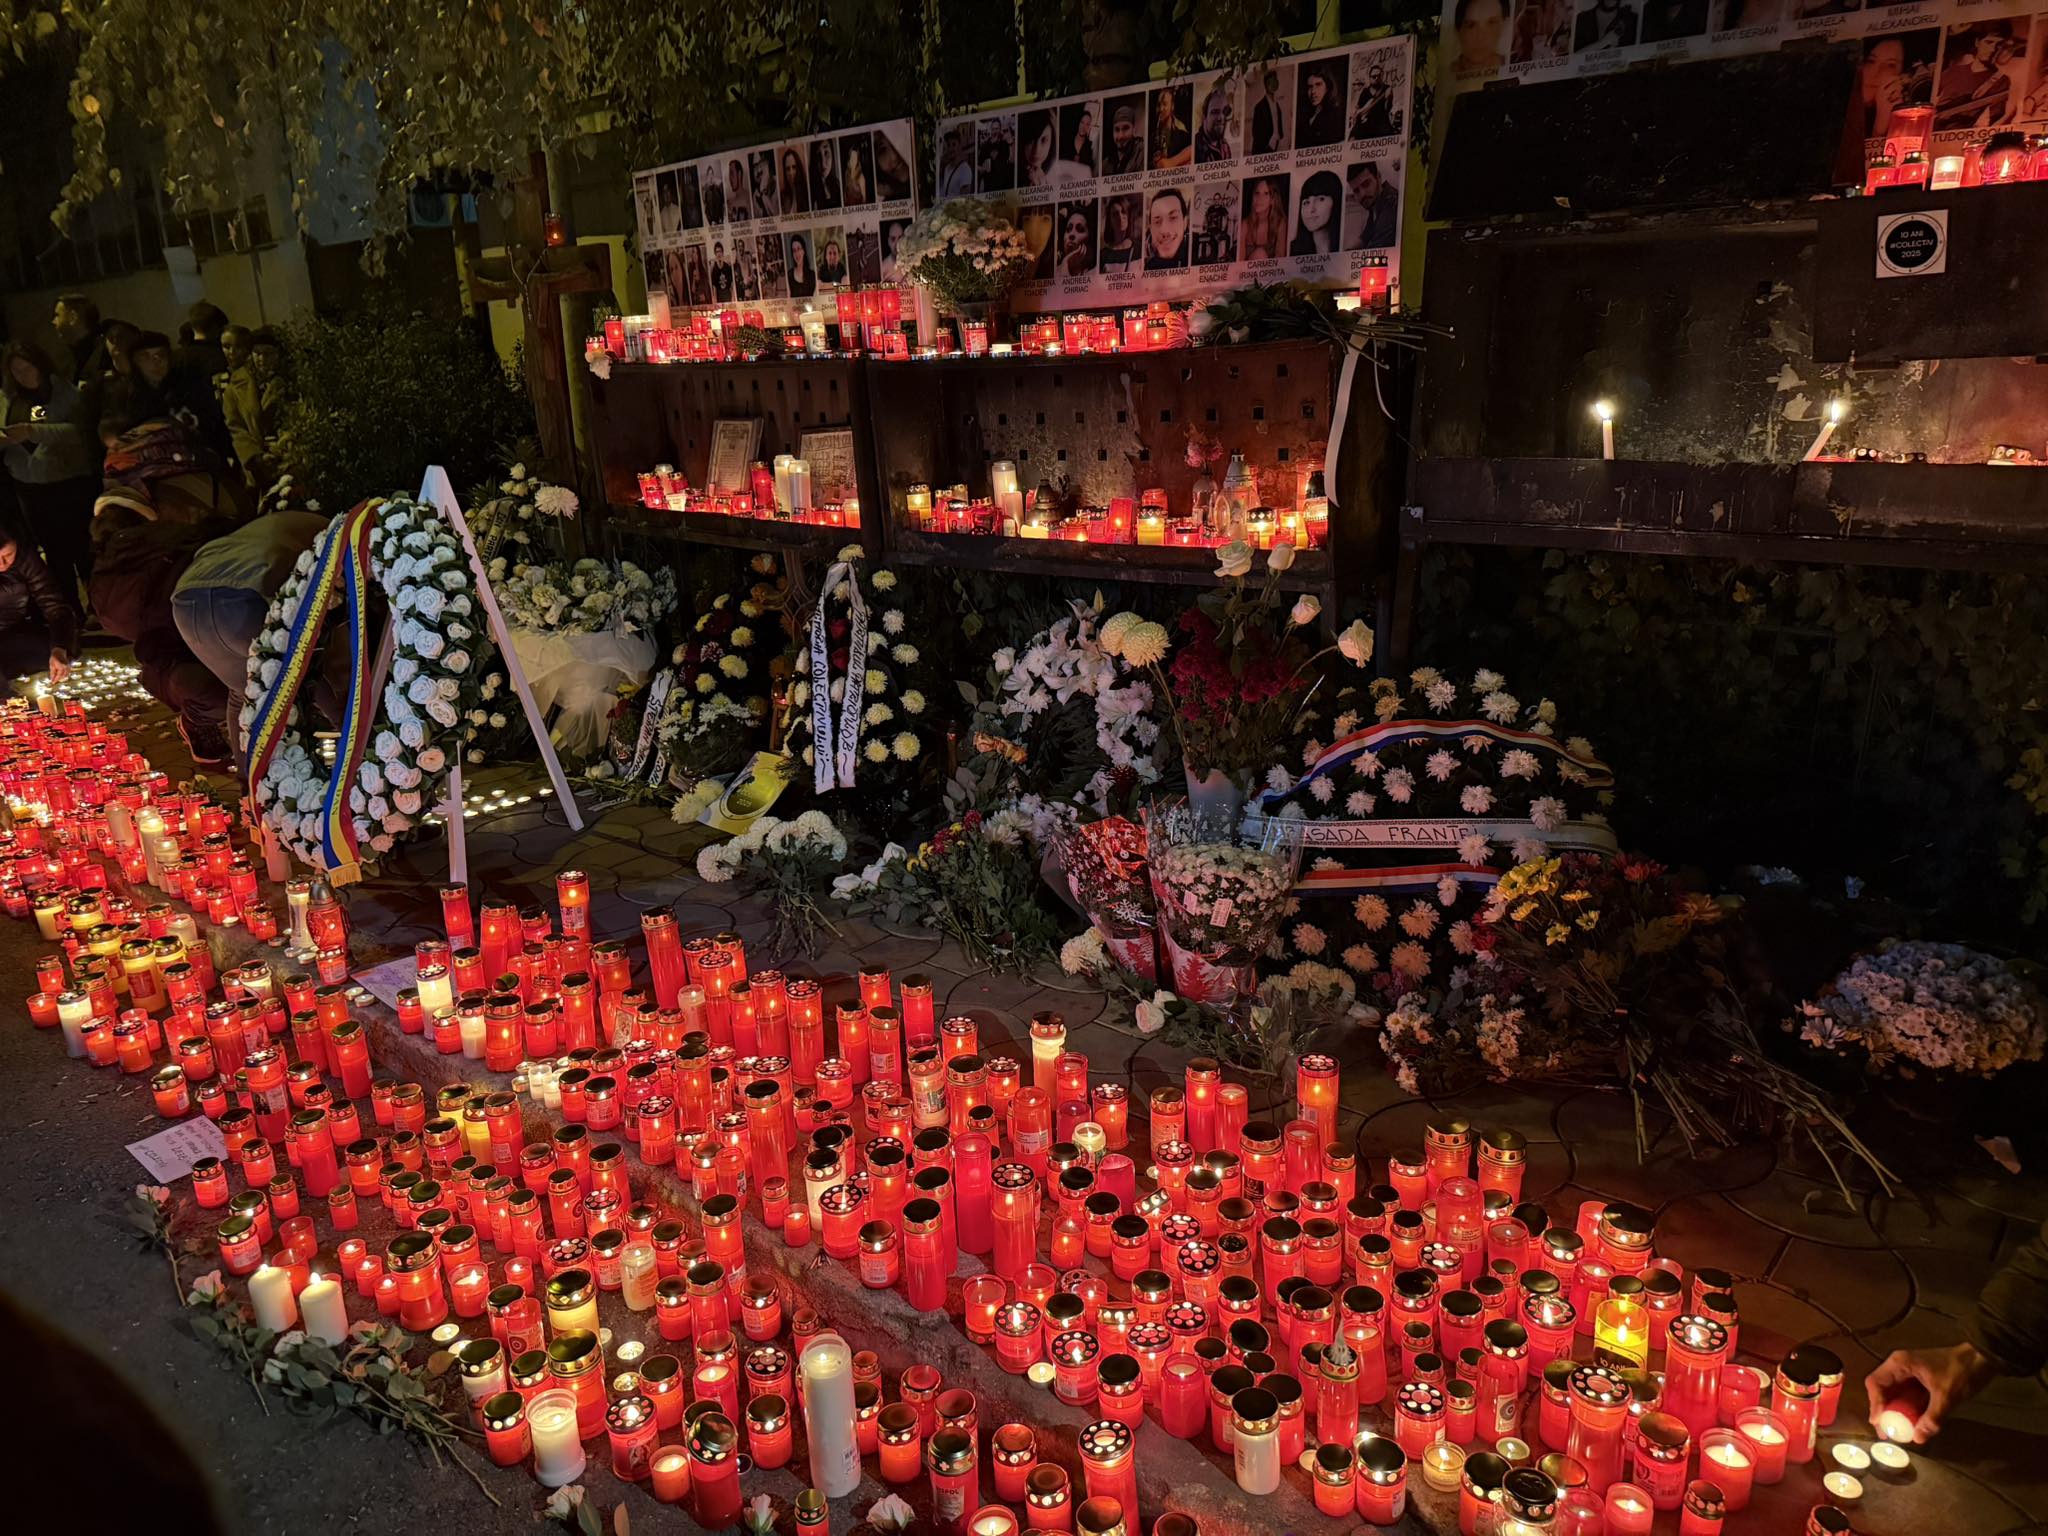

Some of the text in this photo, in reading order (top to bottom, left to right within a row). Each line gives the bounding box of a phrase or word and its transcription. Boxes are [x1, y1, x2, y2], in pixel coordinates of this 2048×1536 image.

[1866, 14, 1938, 31] ALEXANDRU
[1933, 130, 1974, 142] TUDOR
[1351, 136, 1399, 150] ALEXANDRU
[1296, 146, 1342, 159] ALEXANDRU
[1360, 150, 1387, 161] PASCU
[1245, 152, 1288, 165] ALEXANDRU
[1296, 155, 1342, 168] MIHAI IANCU
[1196, 160, 1238, 172] ALEXANDRU
[1254, 164, 1279, 174] HOGEA
[1149, 167, 1189, 179] ALEXANDRU
[1203, 170, 1230, 181] CHELBA
[1059, 179, 1097, 190] ALEXANDRA
[1103, 174, 1142, 185] ALEXANDRU
[1142, 176, 1195, 190] CATALIN SIMION
[1019, 185, 1054, 196] ALEXANDRA
[1060, 188, 1097, 199] RADULESCU
[1110, 183, 1134, 193] ALIMAN
[1022, 194, 1049, 205] MATACHE
[1900, 231, 1909, 239] 10
[1295, 254, 1331, 265] CATALINA
[1900, 250, 1921, 258] 2025
[1199, 263, 1229, 273] BOGDAN
[1248, 259, 1278, 269] CARMEN
[1300, 265, 1324, 274] IONITA
[1105, 272, 1136, 282] ANDREEA
[1142, 270, 1168, 280] AYBERK
[1199, 273, 1228, 283] ENACHE
[1239, 268, 1286, 280] IRINA OPRITA
[1062, 277, 1091, 286] ANDREEA
[1108, 281, 1133, 291] STEFAN
[1024, 288, 1048, 298] TOADER
[1064, 285, 1089, 295] CHIRIAC
